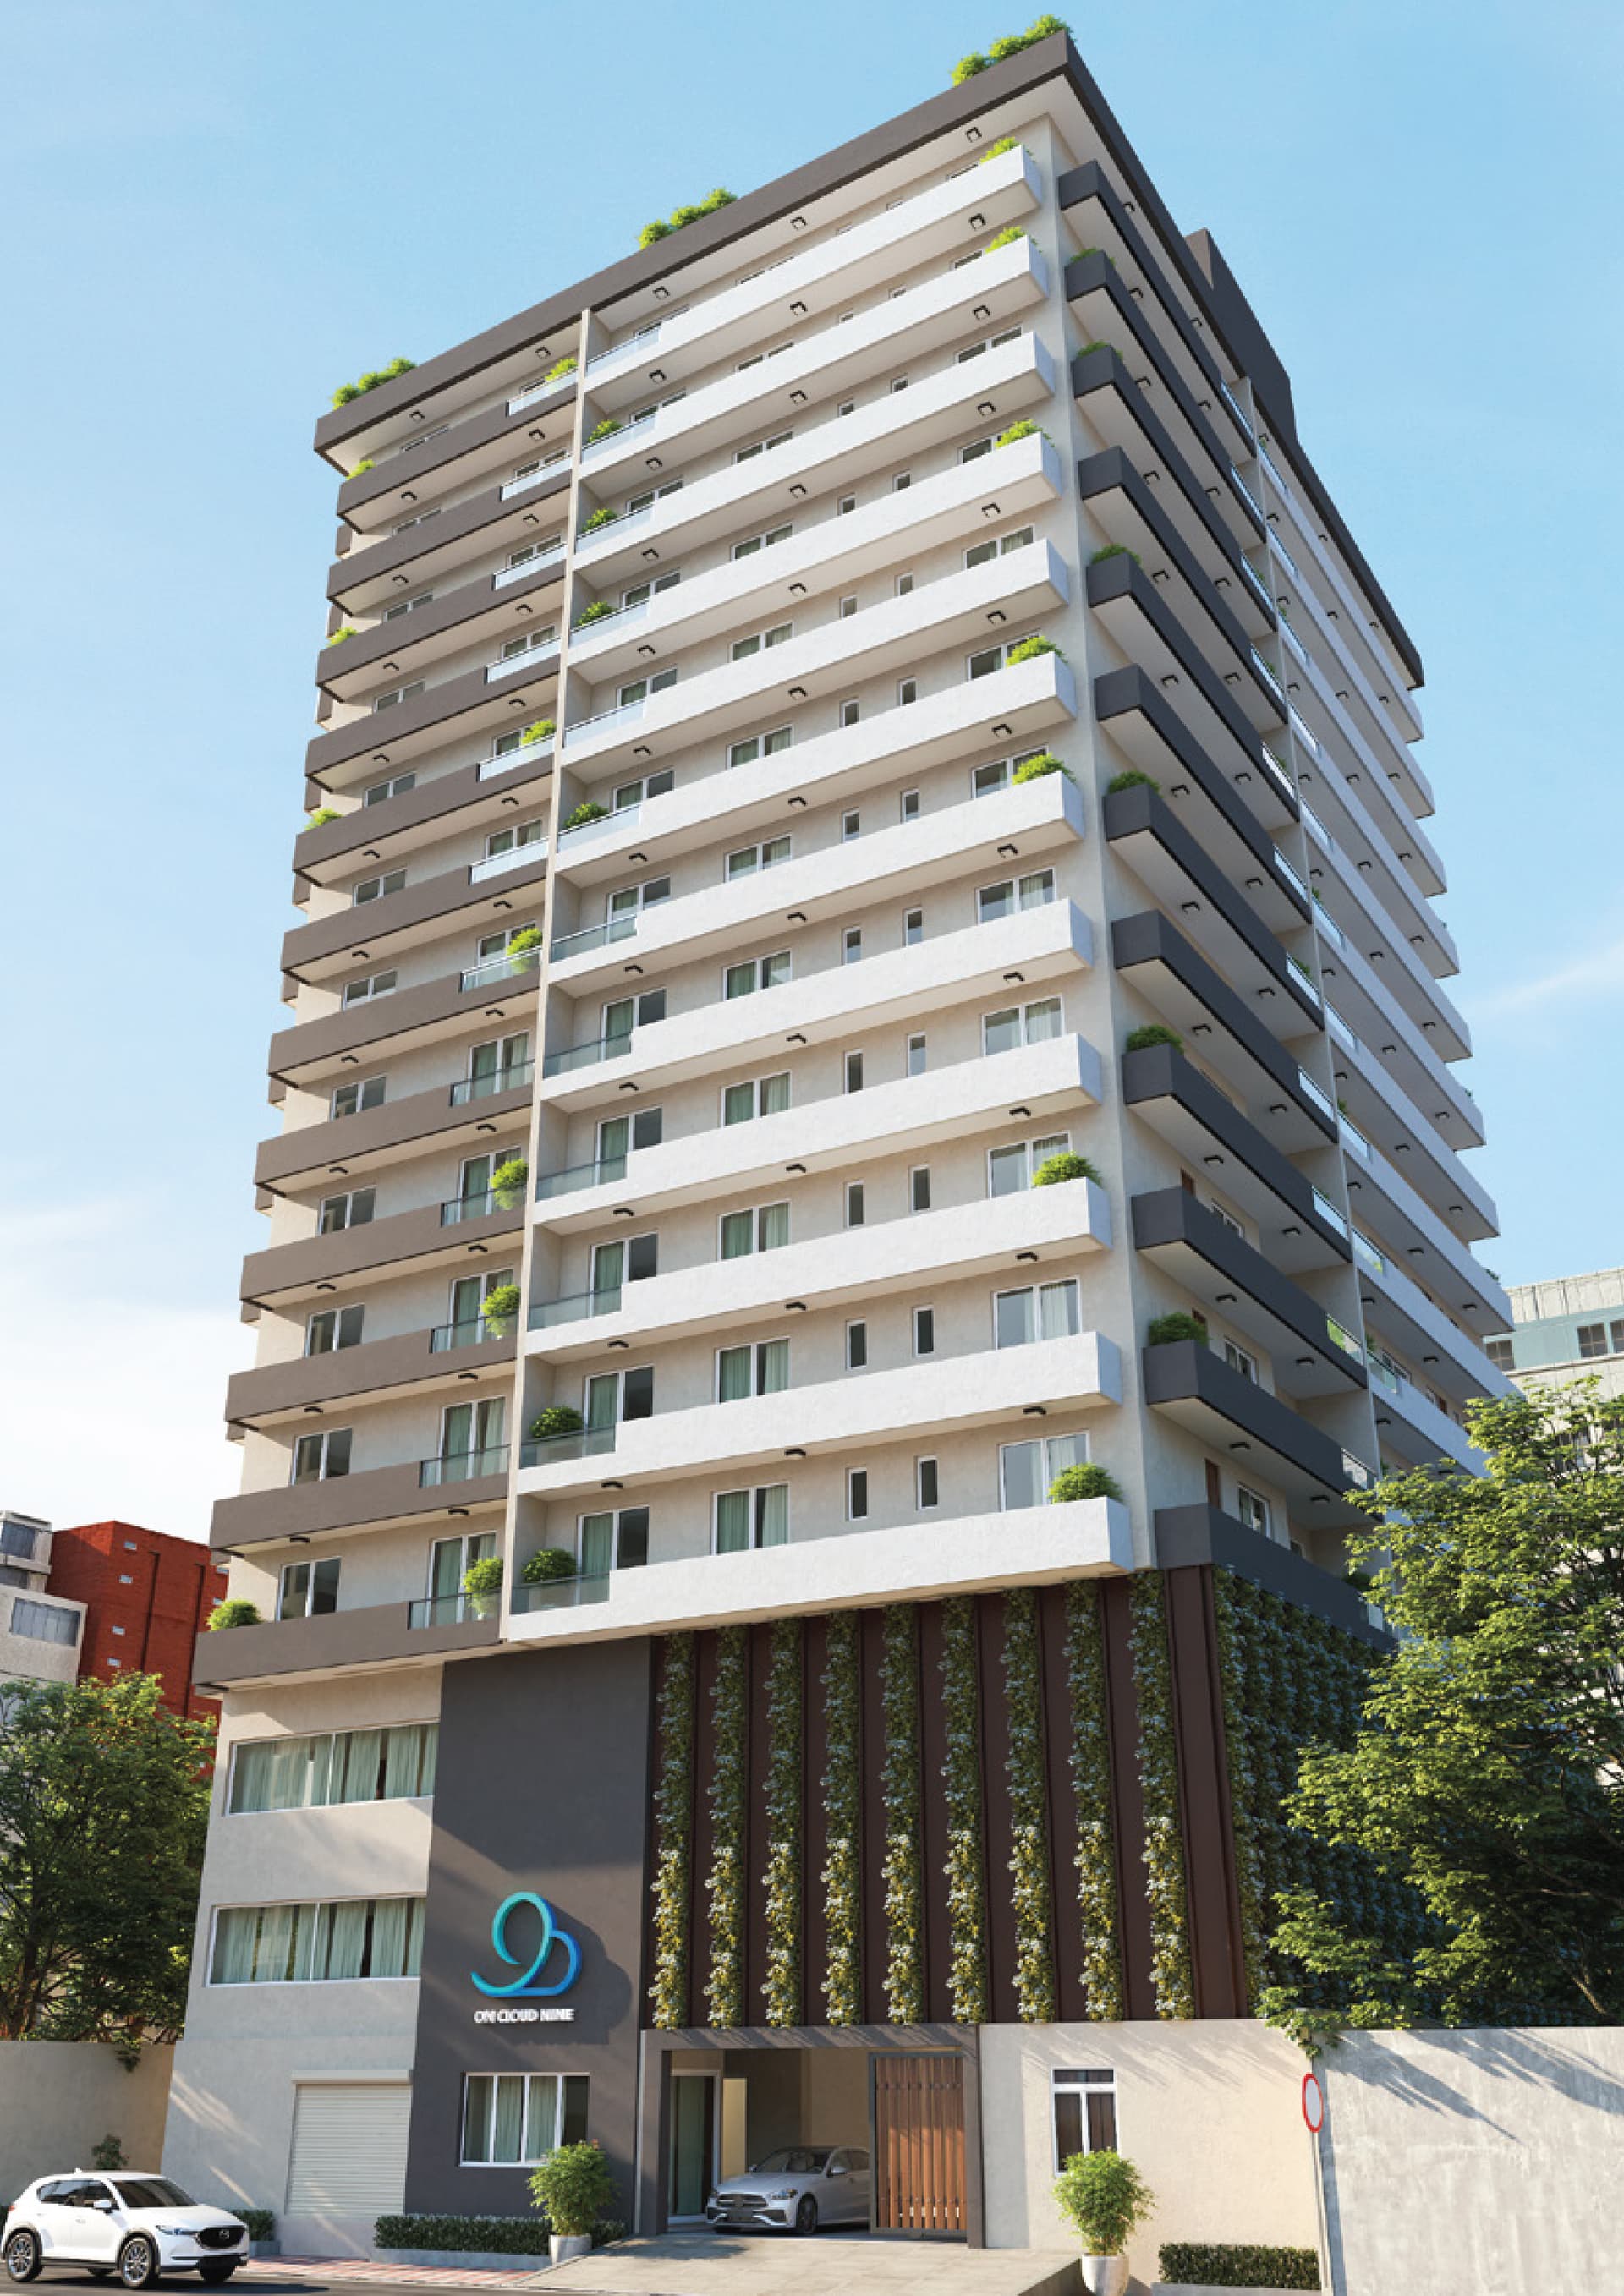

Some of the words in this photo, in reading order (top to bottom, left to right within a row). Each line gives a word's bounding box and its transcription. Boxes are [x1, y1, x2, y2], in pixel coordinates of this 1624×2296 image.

[474, 2009, 496, 2023] ON
[497, 2009, 539, 2023] CLOUD
[540, 2009, 574, 2022] NINE
